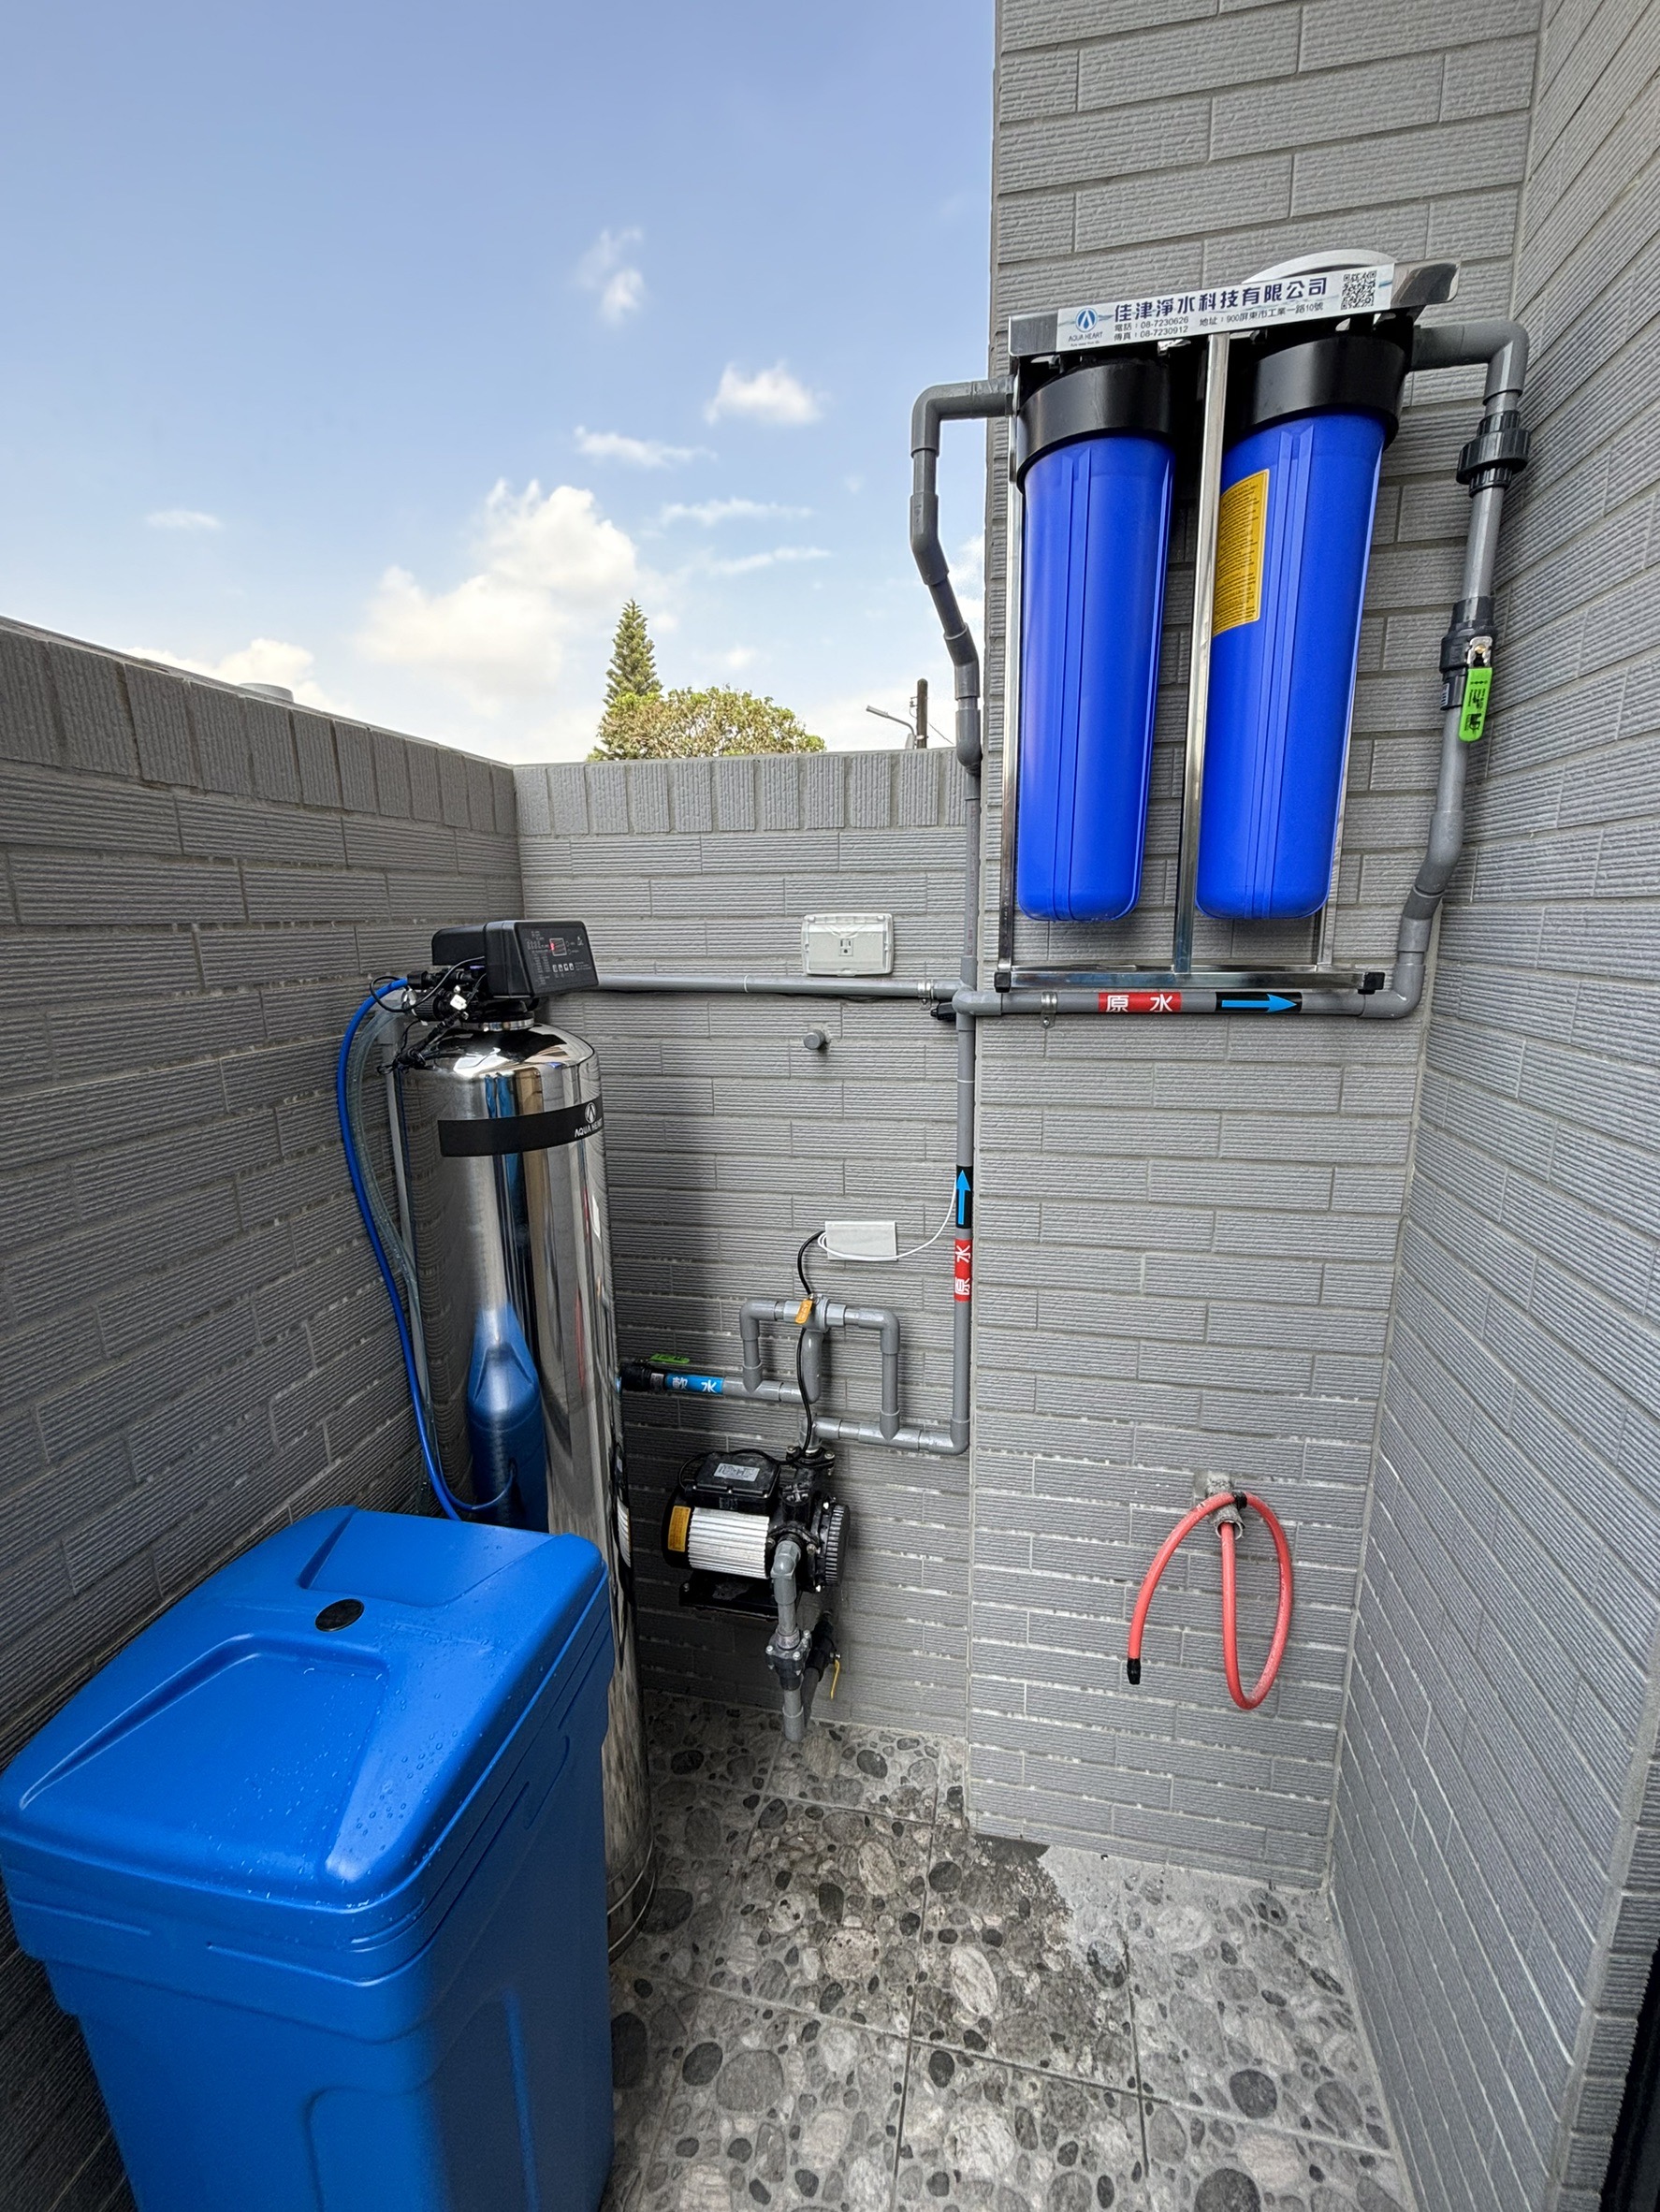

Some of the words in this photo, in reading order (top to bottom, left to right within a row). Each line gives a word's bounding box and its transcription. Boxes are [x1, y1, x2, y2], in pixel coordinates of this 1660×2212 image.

[1114, 277, 1327, 323] 佳津淨水科技有限公司
[1069, 333, 1084, 342] AQUA
[1085, 331, 1103, 341] HEART
[575, 1124, 591, 1138] AQUA
